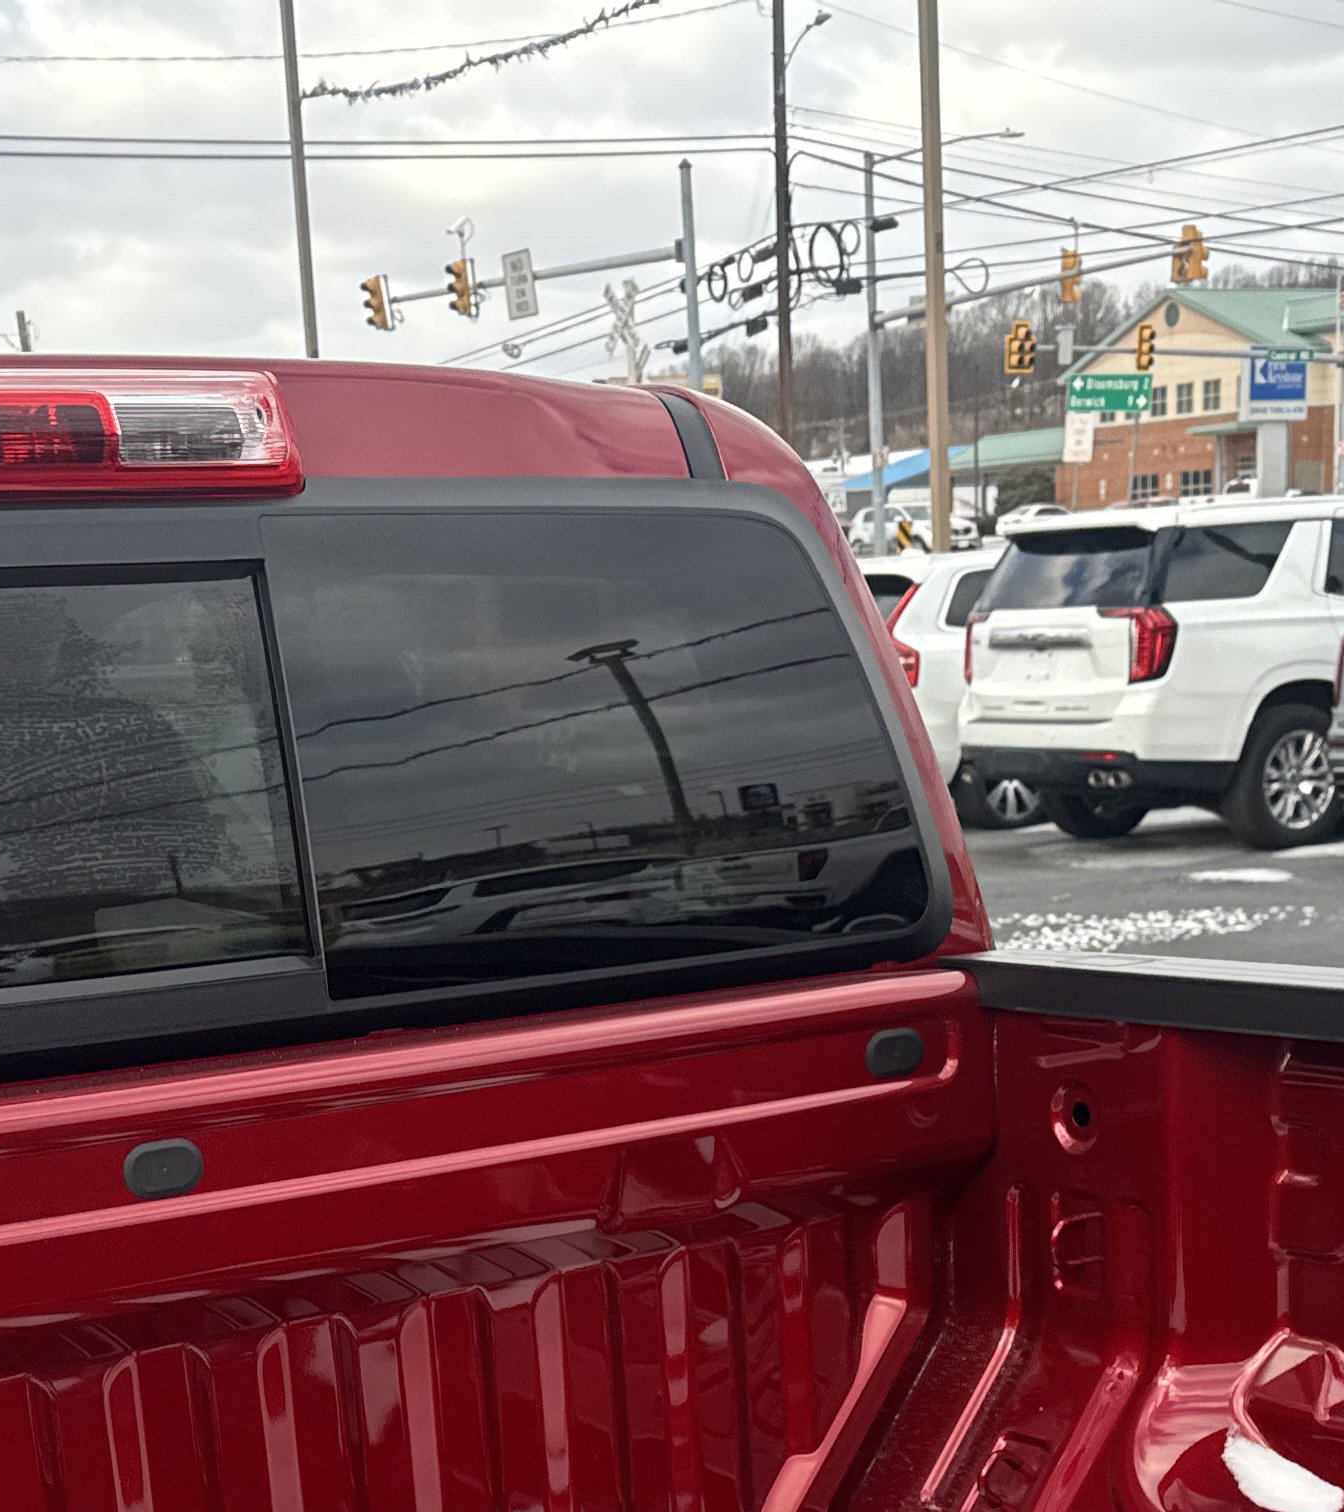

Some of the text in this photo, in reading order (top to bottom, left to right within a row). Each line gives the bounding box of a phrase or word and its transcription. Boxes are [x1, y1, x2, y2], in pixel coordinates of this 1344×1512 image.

[1086, 376, 1150, 392] Bloomsburg 2
[1070, 395, 1106, 408] Berwick
